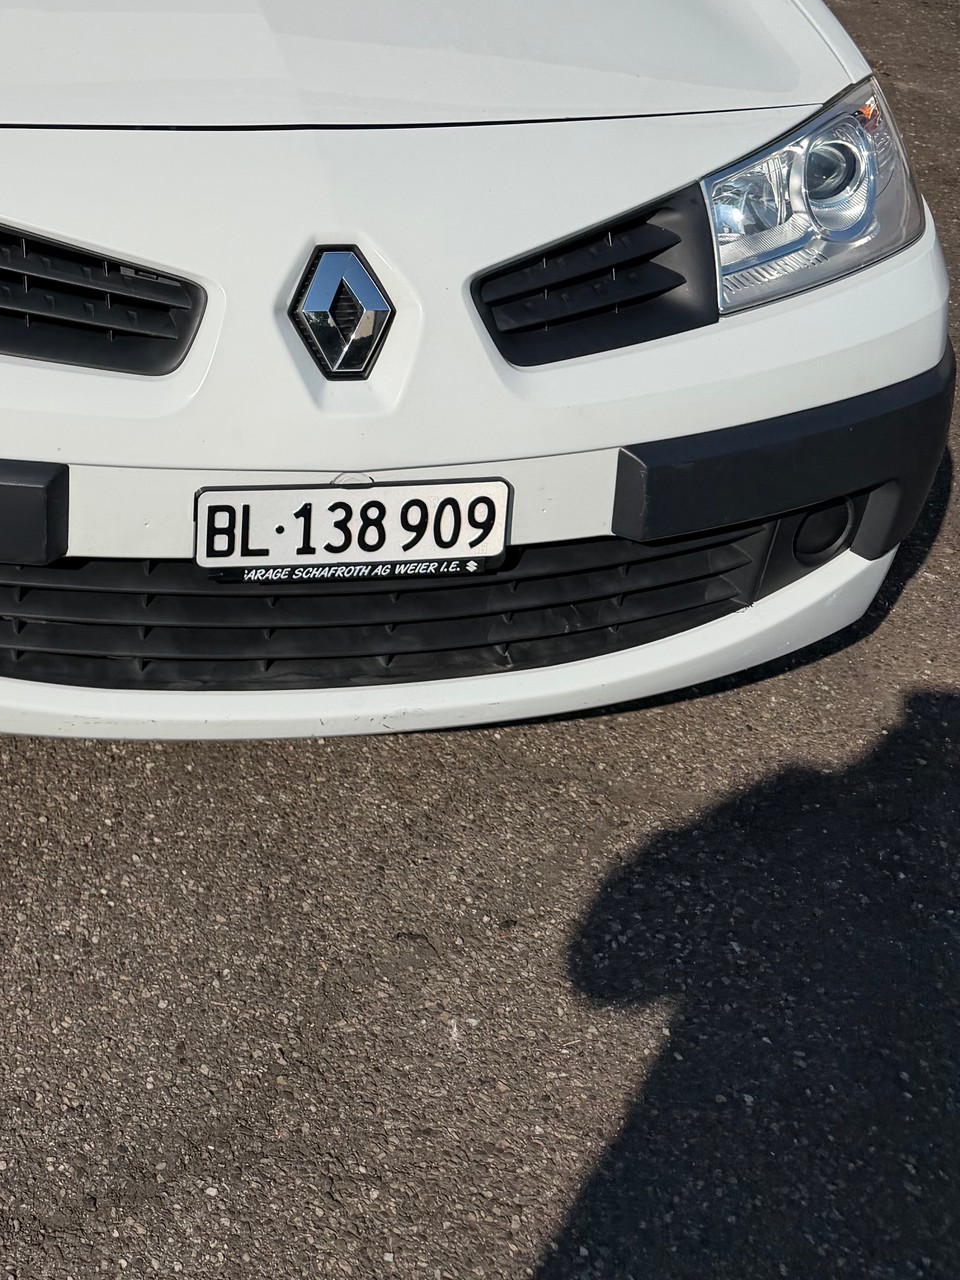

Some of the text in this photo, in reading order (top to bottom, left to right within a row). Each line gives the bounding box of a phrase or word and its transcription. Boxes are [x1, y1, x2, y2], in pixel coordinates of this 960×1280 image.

[243, 561, 461, 581] ARAGE SCHAFROTH AG WEIER I.E.
